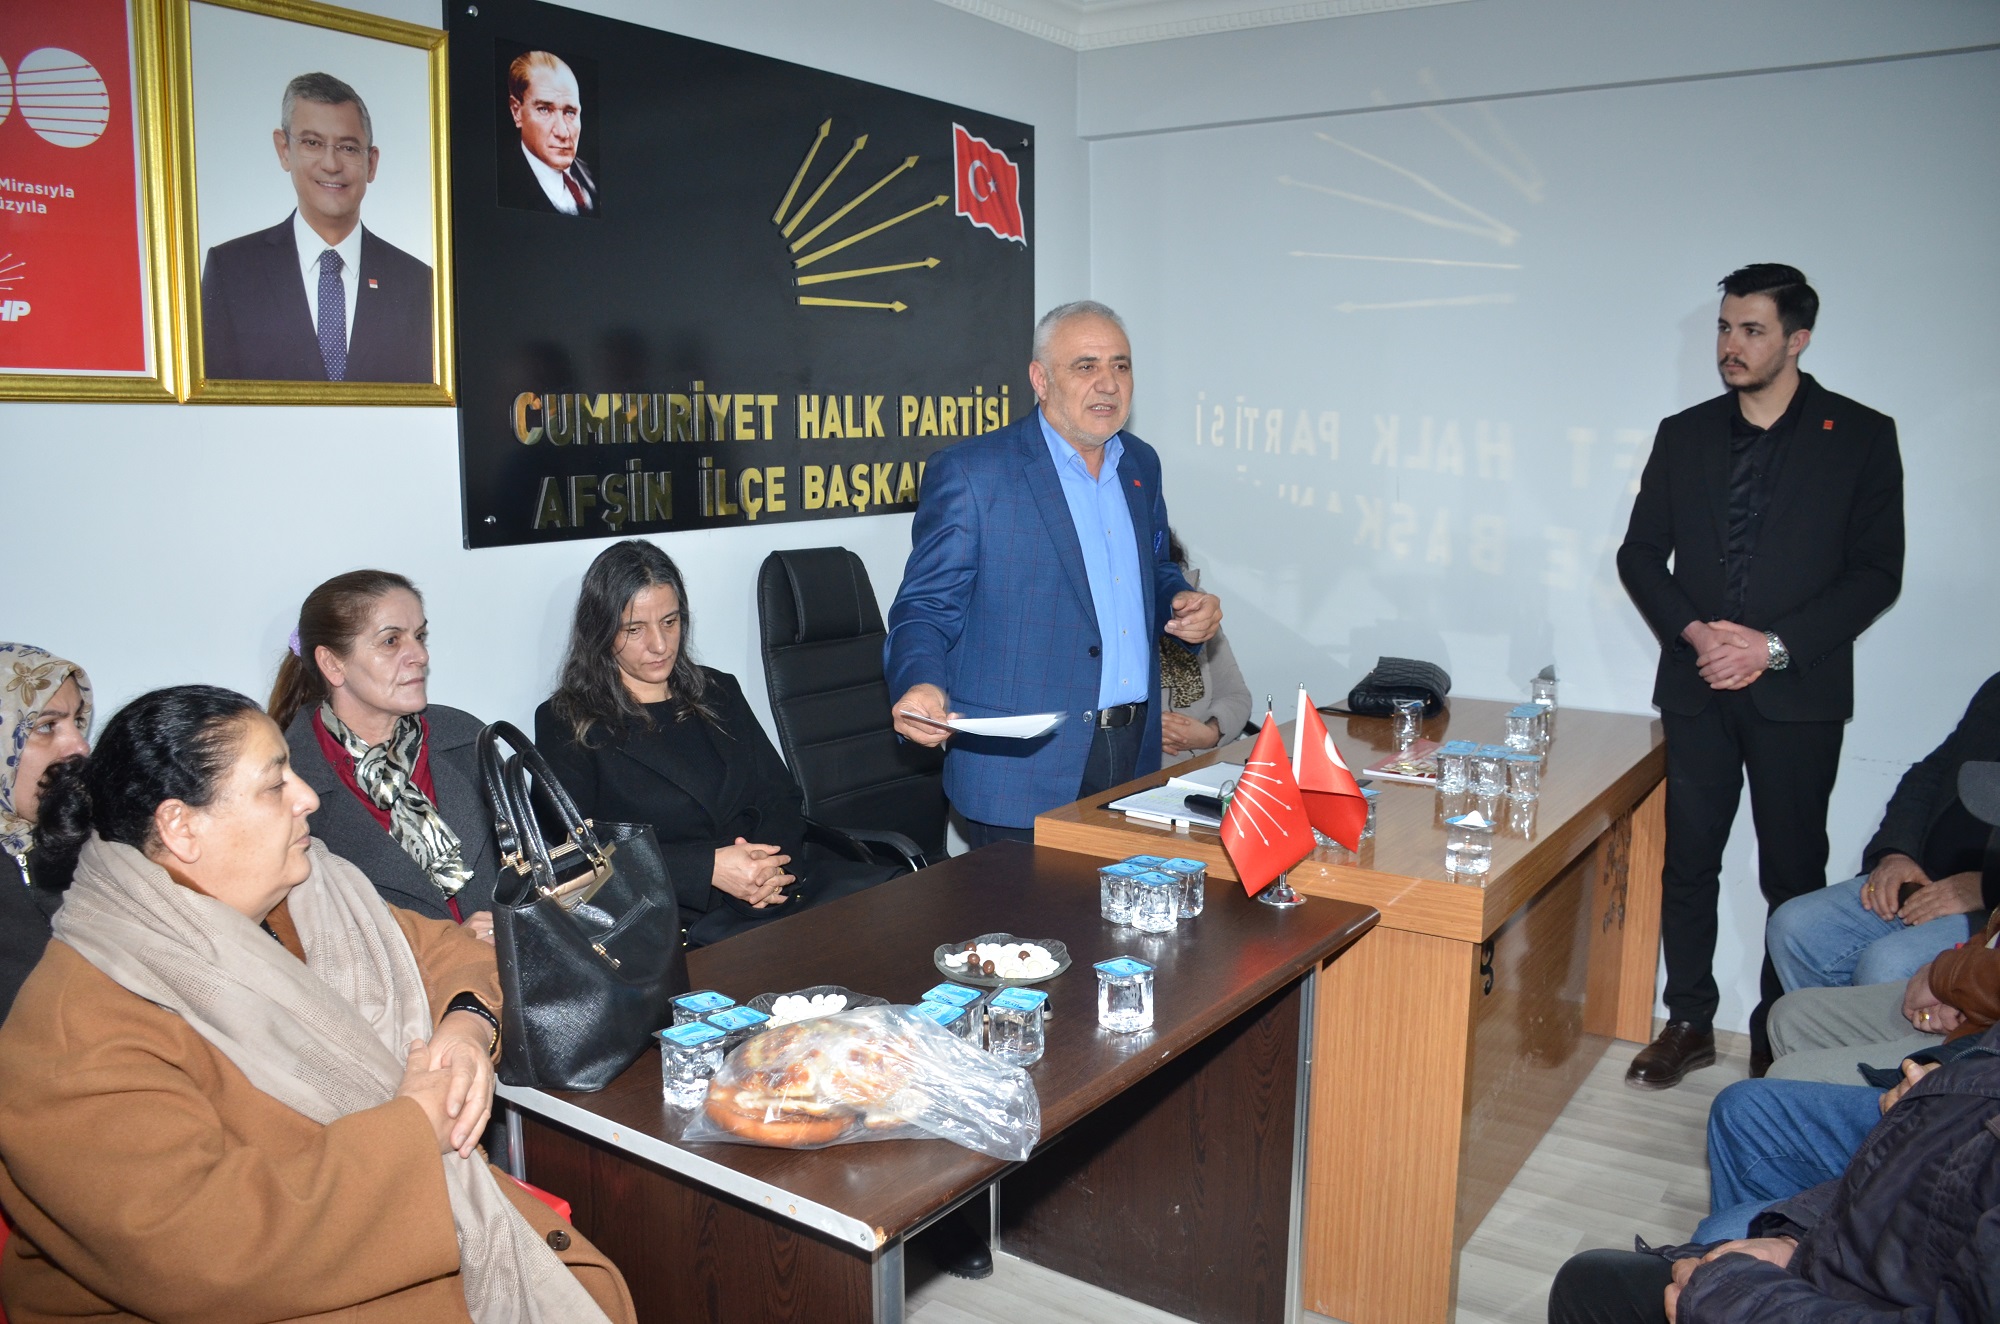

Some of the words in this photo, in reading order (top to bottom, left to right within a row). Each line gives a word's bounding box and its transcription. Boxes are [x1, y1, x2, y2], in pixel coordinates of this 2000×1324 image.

[0, 178, 75, 198] Mirasıyla
[512, 380, 778, 446] CUMHURİYET
[798, 394, 885, 439] HALK
[901, 385, 1009, 437] PARTİSİ
[532, 458, 673, 531] AFŞİN
[700, 456, 786, 520] İLÇE
